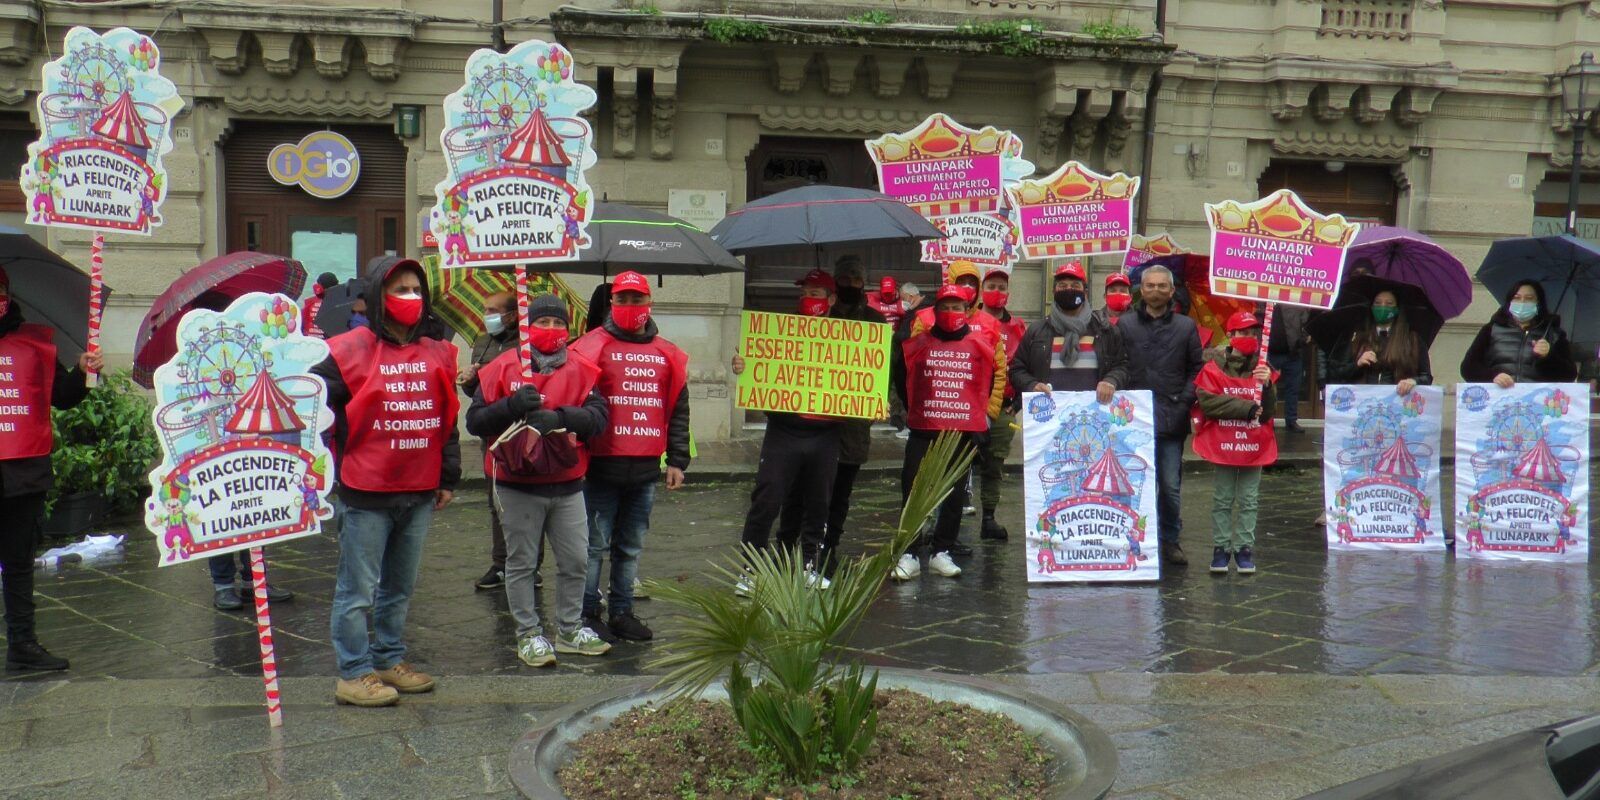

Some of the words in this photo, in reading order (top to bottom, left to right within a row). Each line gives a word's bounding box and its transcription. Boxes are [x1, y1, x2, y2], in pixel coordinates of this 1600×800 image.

[64, 154, 140, 181] RIACCENDETE
[906, 159, 974, 174] LUNAPARK
[63, 172, 80, 188] LA
[894, 171, 966, 185] DIVERTIMENTO
[933, 178, 989, 191] ALL'APERTO
[86, 188, 112, 199] APRITE
[474, 183, 561, 204] RIACCENDETE
[930, 193, 944, 201] DA
[947, 190, 962, 199] UN
[966, 187, 998, 198] ANNO
[62, 198, 66, 210] I
[69, 198, 131, 217] LUNAPARK
[1042, 203, 1106, 217] LUNAPARK
[475, 206, 494, 223] LA
[1031, 214, 1098, 226] DIVERTIMENTO
[501, 219, 531, 229] APRITE
[948, 216, 1004, 232] RIACCENDETE
[1067, 221, 1120, 231] ALL'APERTO
[476, 235, 480, 247] I
[485, 231, 554, 247] LUNAPARK
[1026, 234, 1062, 243] CHIUSO
[1064, 233, 1078, 241] DA
[1081, 231, 1095, 240] UN
[1098, 229, 1127, 238] ANNO
[619, 239, 682, 248] PROFILTER
[950, 244, 995, 256] LUNAPARK
[1241, 236, 1314, 257] LUNAPARK
[1226, 247, 1303, 266] DIVERTIMENTO
[1265, 263, 1327, 279] ALL'APERTO
[1216, 267, 1257, 280] CHIUSO
[1260, 273, 1275, 284] DA
[1279, 275, 1296, 286] UN
[1299, 279, 1333, 291] ANNO
[750, 312, 770, 334] MI
[775, 314, 863, 343] VERGOGNO
[867, 322, 884, 345] DI
[611, 352, 623, 361] LE
[625, 353, 666, 365] GIOSTRE
[745, 337, 804, 361] ESSERE
[808, 341, 885, 370] ITALIANO
[929, 350, 955, 358] LEGGE
[926, 359, 972, 370] RICONOSCE
[624, 367, 656, 378] SONO
[753, 361, 769, 384] CI
[775, 363, 824, 388] AVETE
[829, 368, 874, 393] TOLTO
[933, 370, 973, 380] FUNZIONE
[385, 381, 405, 393] PER
[622, 381, 659, 393] CHIUSE
[931, 379, 964, 389] SOCIALE
[935, 390, 960, 399] DELLO
[382, 399, 433, 411] TORNARE
[738, 386, 802, 411] LAVORO
[807, 391, 817, 412] E
[822, 392, 884, 418] DIGNITÀ
[924, 400, 971, 410] SPETTACOLO
[632, 411, 648, 421] DA
[923, 410, 970, 420] VIAGGIANTE
[372, 419, 381, 430] A
[614, 425, 630, 435] UN
[632, 427, 661, 437] ANNO
[1235, 431, 1248, 439] DA
[390, 439, 395, 449] I
[399, 438, 429, 450] BIMBI
[1220, 442, 1233, 451] UN
[1235, 443, 1259, 451] ANNO
[196, 456, 297, 486] RIACCENDETE
[198, 488, 221, 509] LA
[1354, 488, 1413, 504] RIACCENDETE
[230, 496, 263, 511] APRITE
[1490, 494, 1557, 512] RIACCENDETE
[1355, 504, 1368, 516] LA
[201, 522, 207, 536] I
[212, 505, 291, 534] LUNAPARK
[1060, 508, 1127, 527] RIACCENDETE
[1490, 511, 1504, 523] LA
[1060, 527, 1075, 541] LA
[1362, 524, 1409, 534] LUNAPARK
[1080, 538, 1103, 546] APRITE
[1496, 531, 1549, 542] LUNAPARK
[1060, 549, 1064, 560] I
[1067, 548, 1121, 560] LUNAPARK
